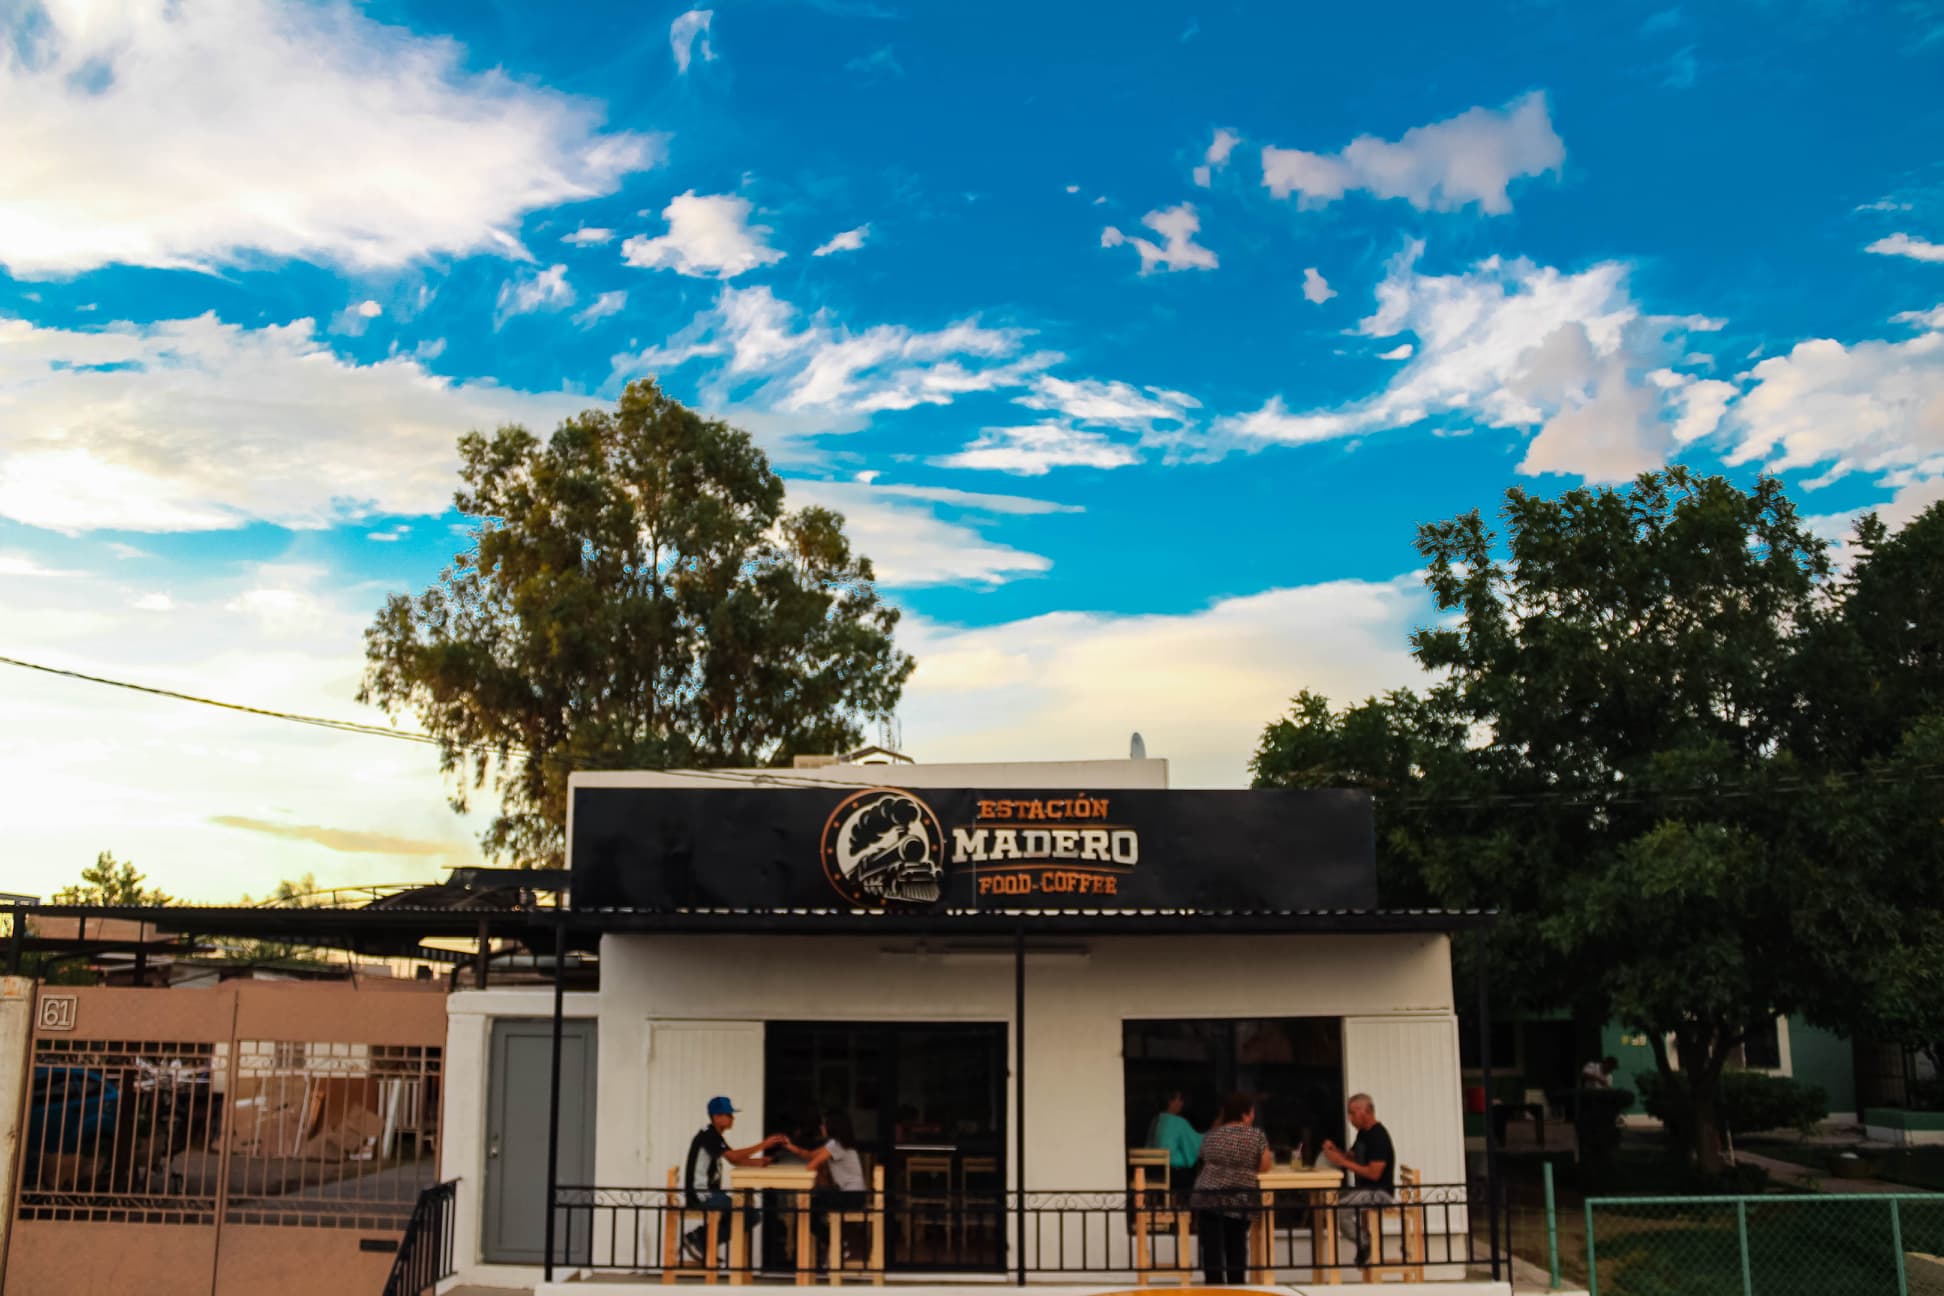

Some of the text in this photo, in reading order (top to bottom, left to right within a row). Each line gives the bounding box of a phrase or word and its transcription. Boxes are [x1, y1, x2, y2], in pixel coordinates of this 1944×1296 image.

[978, 792, 1109, 820] ESTACIÓN
[951, 828, 1138, 865] MADERO
[978, 871, 1118, 896] FOOD-COFFEE
[43, 999, 71, 1026] 61
